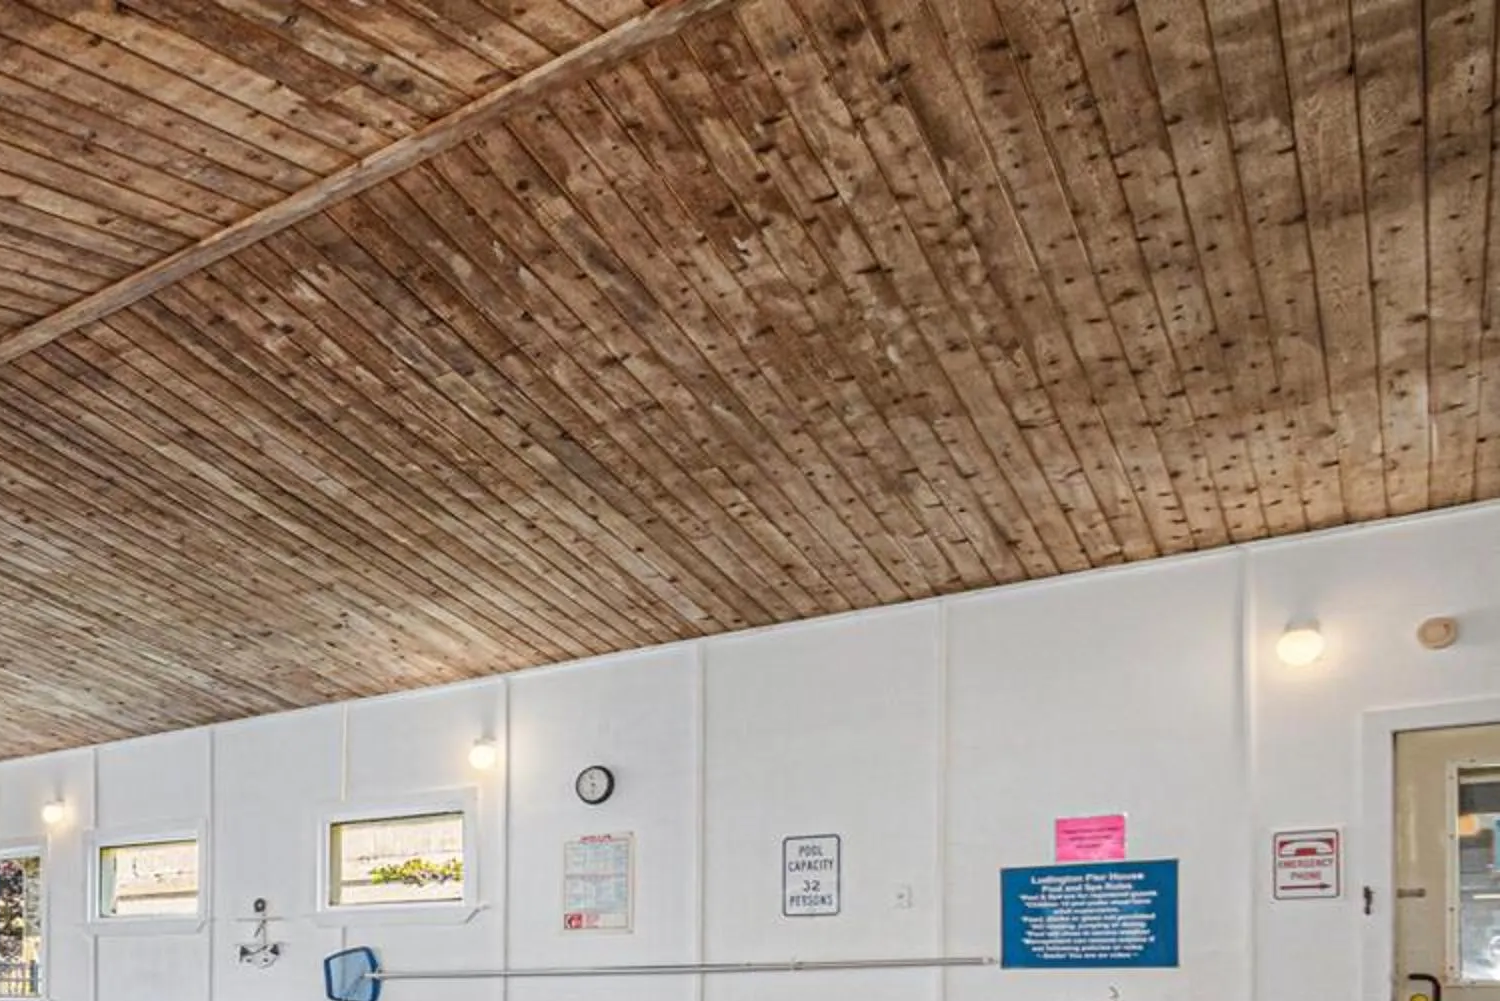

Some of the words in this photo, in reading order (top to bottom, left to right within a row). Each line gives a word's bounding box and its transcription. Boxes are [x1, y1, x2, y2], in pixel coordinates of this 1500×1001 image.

[799, 845, 823, 856] POOL
[788, 858, 834, 872] CAPACITY
[803, 880, 820, 893] 32
[790, 895, 833, 907] PERSONS
